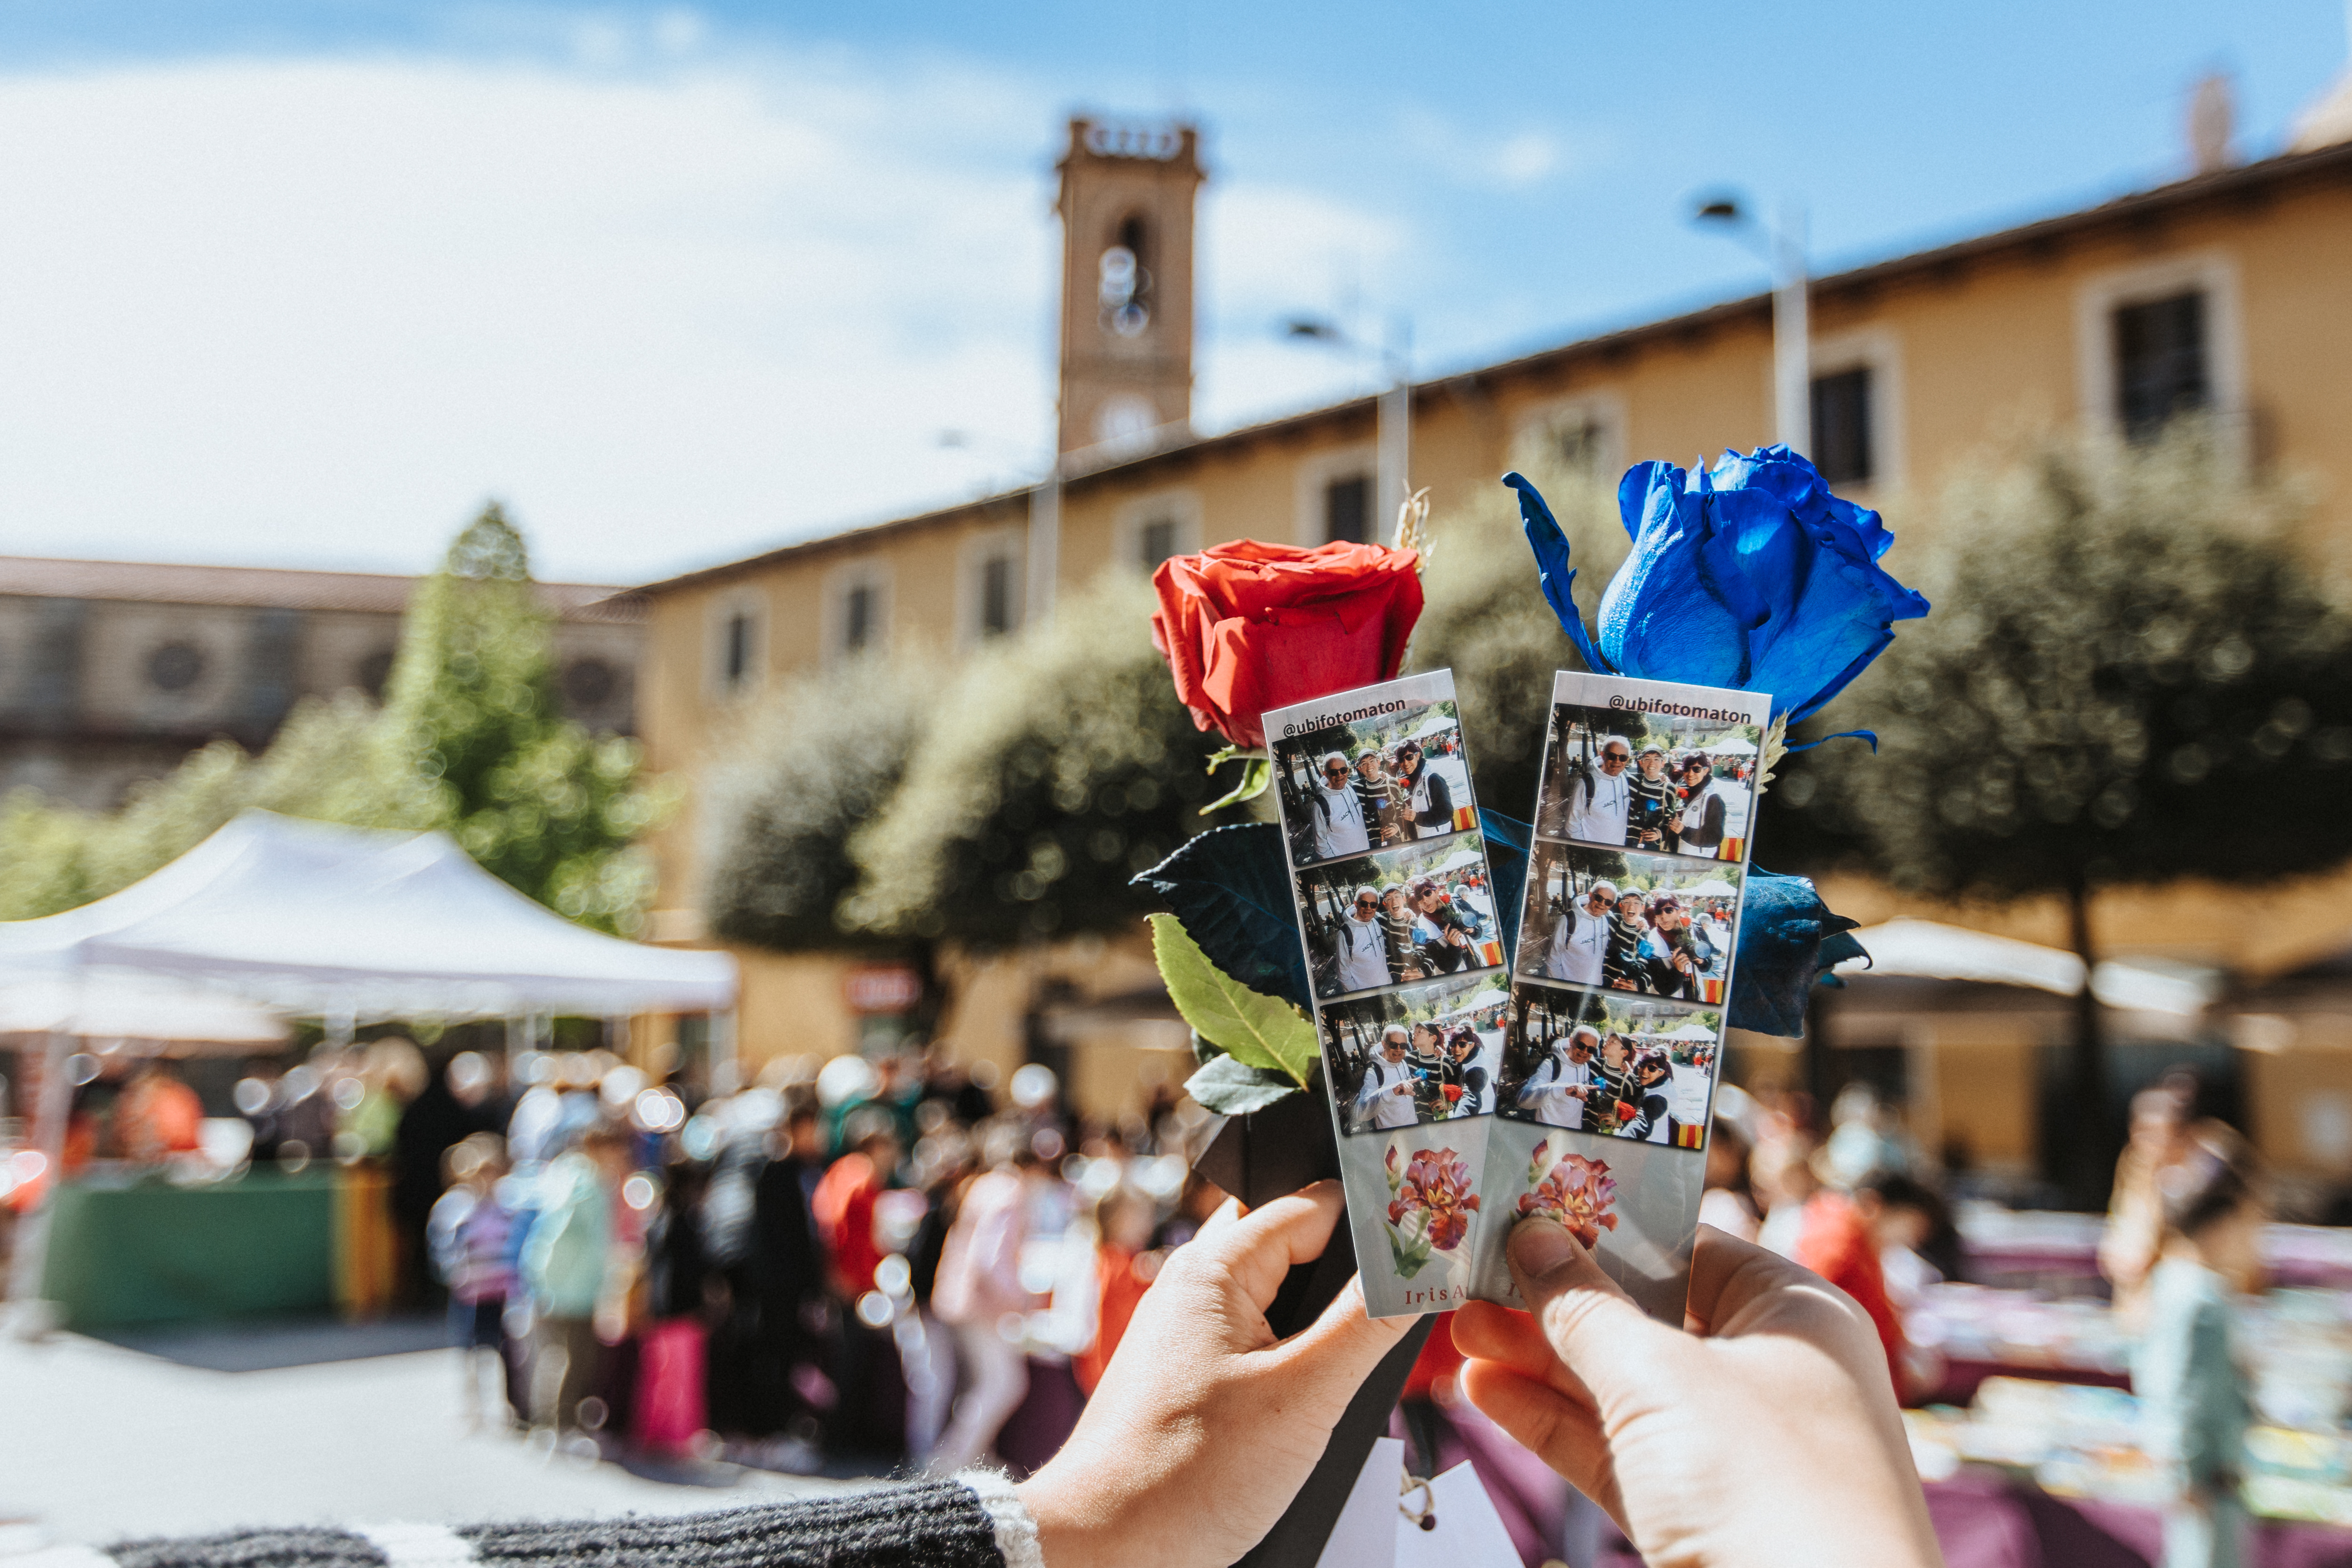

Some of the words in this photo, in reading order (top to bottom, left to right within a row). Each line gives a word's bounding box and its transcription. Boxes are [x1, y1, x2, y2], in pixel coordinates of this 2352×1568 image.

[1283, 699, 1406, 738] @ubifotomaton
[1609, 695, 1751, 724] @ubifotomaton
[1405, 1284, 1468, 1305] IrisA
